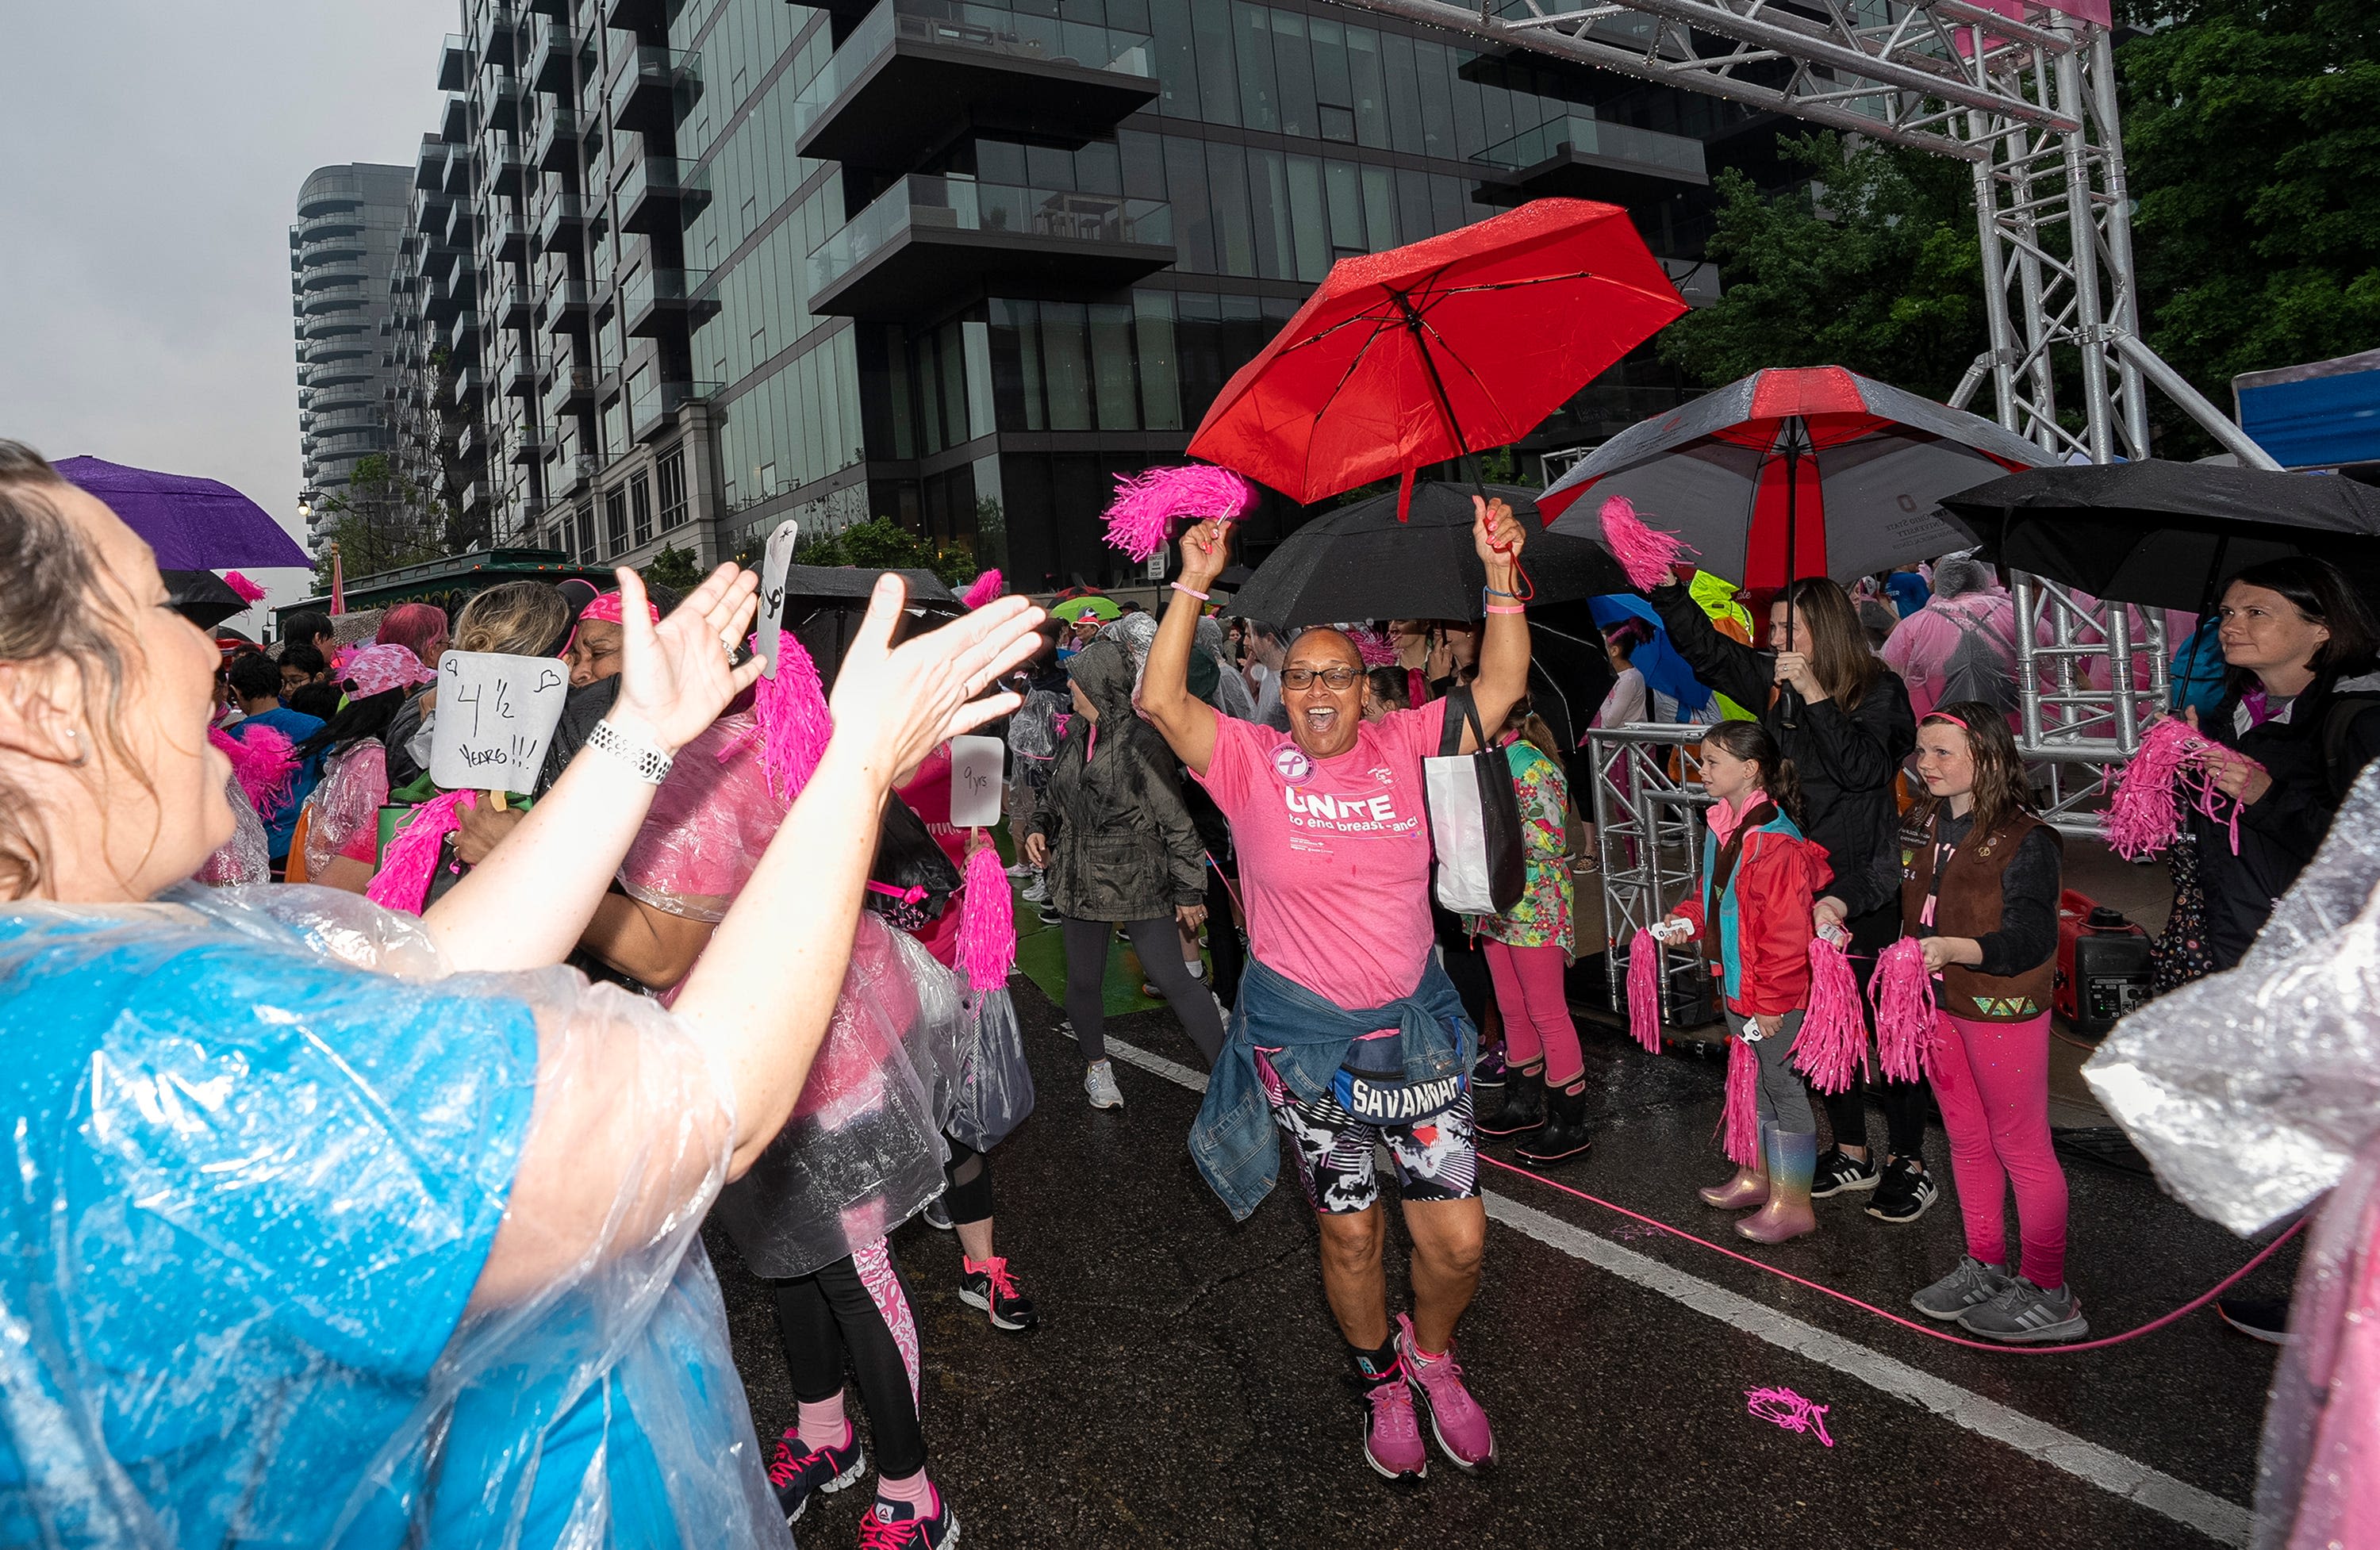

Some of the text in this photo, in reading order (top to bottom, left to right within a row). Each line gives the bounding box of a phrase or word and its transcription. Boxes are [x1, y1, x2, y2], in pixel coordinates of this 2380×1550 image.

[457, 684, 482, 739] 4
[1288, 813, 1303, 826] to
[1353, 1076, 1460, 1118] SAVANNAH
